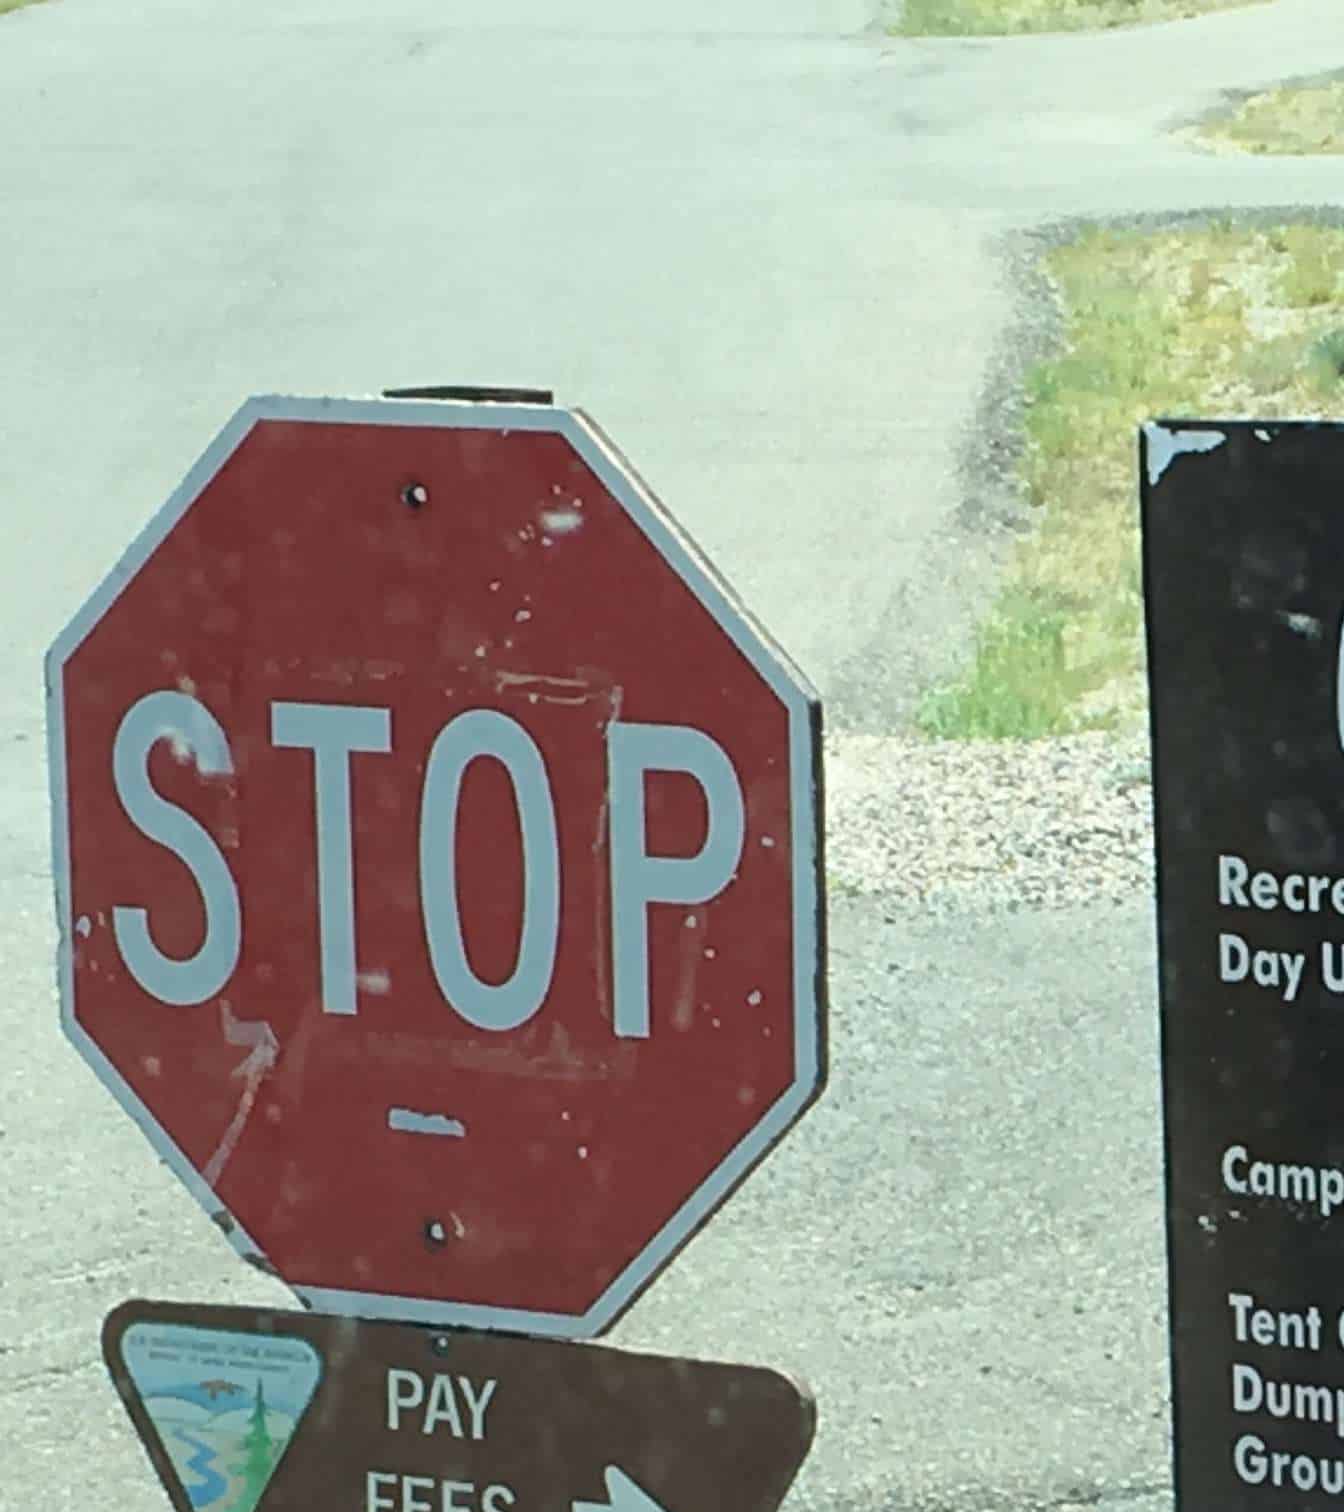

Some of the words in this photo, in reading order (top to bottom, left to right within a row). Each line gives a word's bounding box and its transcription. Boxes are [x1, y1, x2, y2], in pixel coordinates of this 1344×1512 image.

[111, 690, 747, 1039] STOP
[1218, 932, 1306, 1002] Day
[1228, 1292, 1322, 1351] Tent
[386, 1369, 498, 1440] PAY
